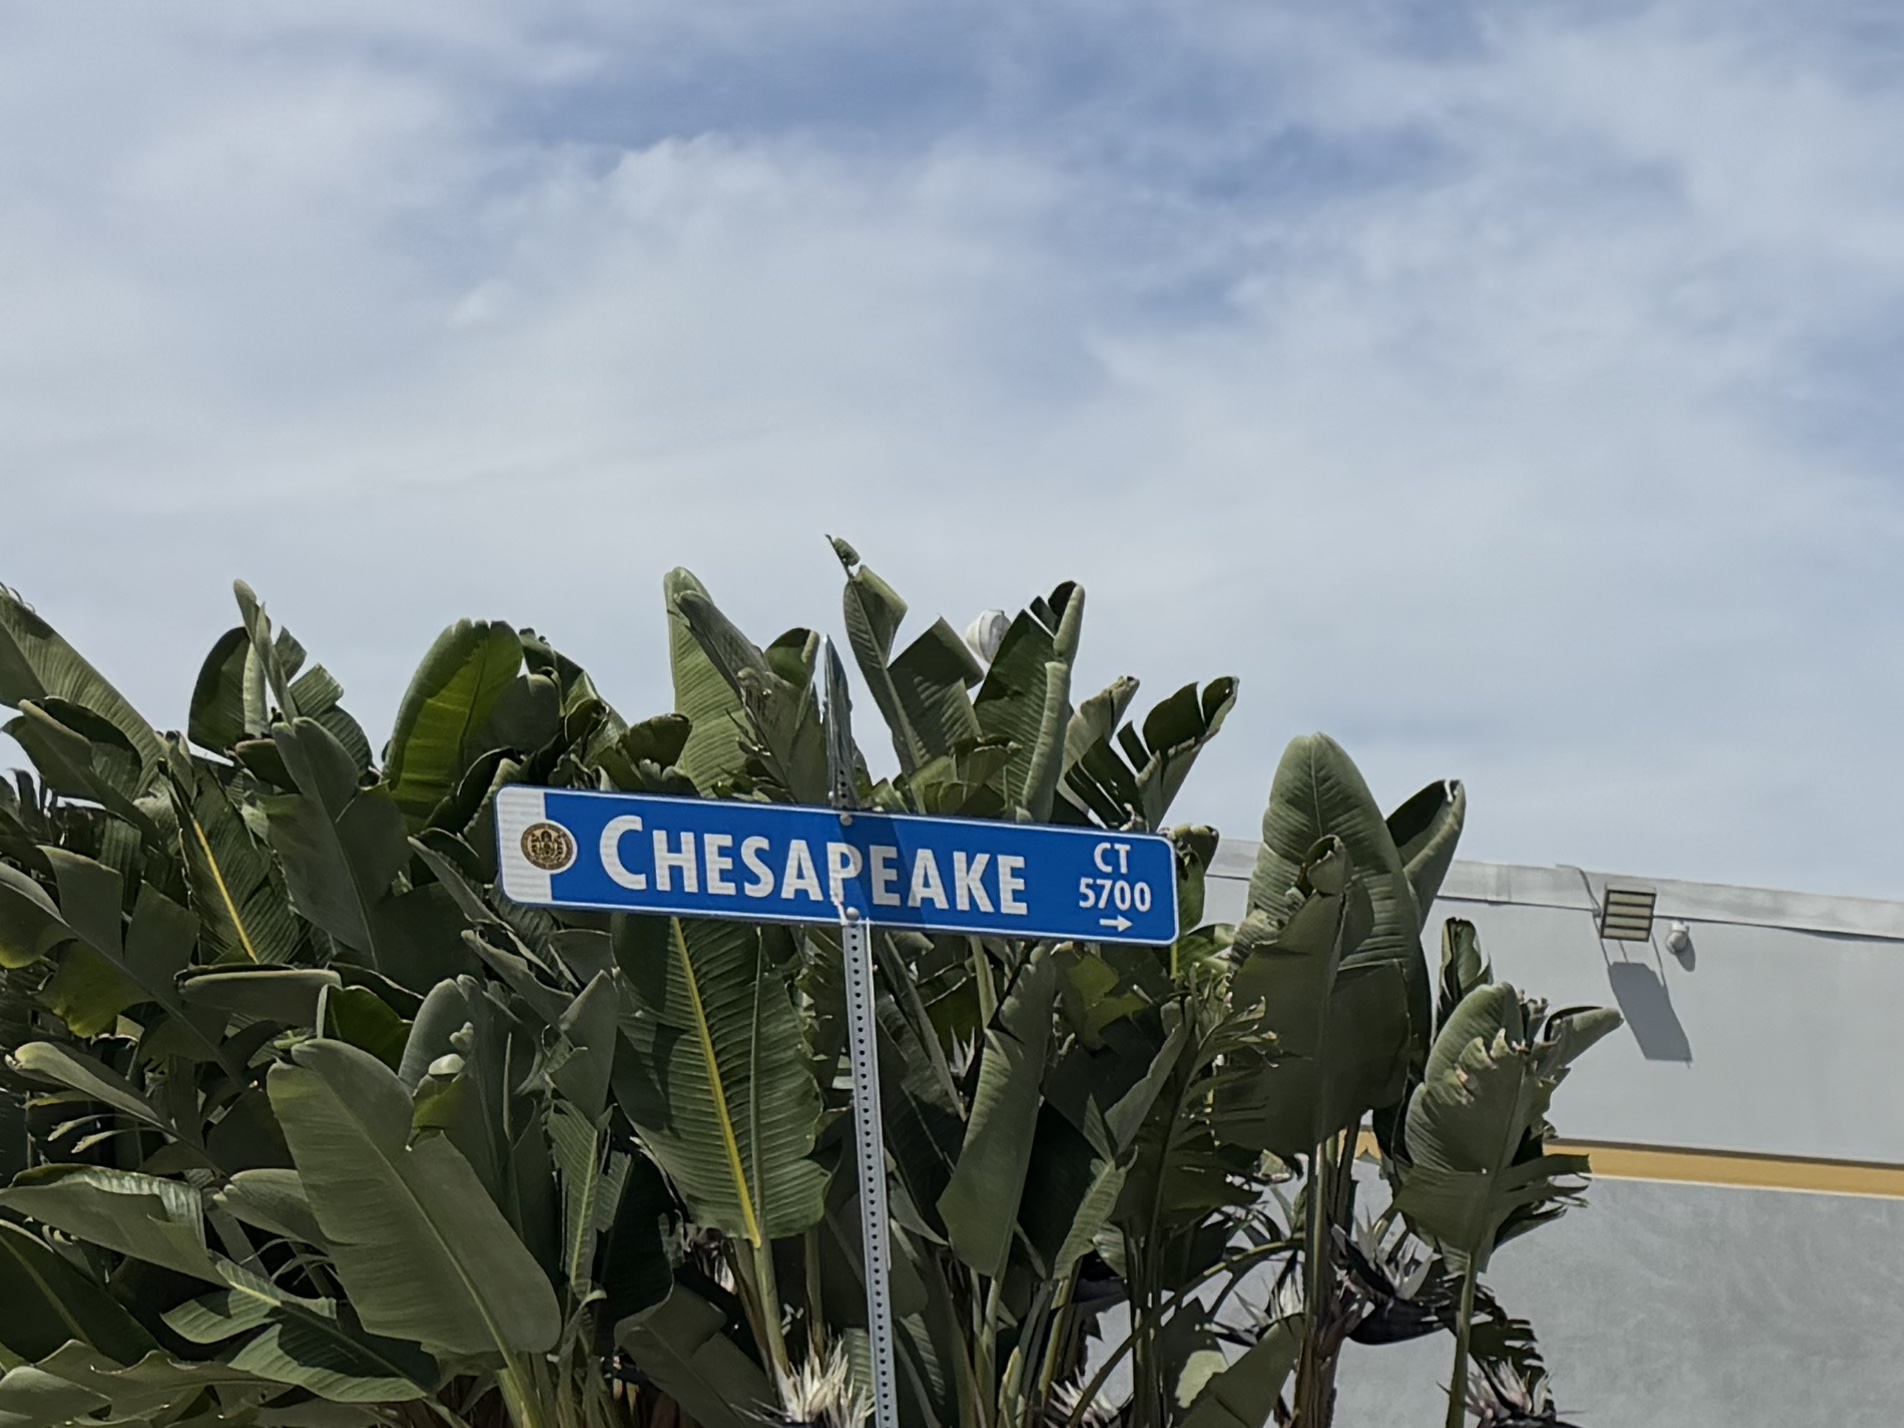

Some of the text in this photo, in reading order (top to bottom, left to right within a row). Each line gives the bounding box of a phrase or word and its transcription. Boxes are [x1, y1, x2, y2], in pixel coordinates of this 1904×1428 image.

[600, 814, 1028, 915] CHESAPEAKE
[1093, 842, 1132, 875] CT
[1077, 876, 1152, 913] 5700
